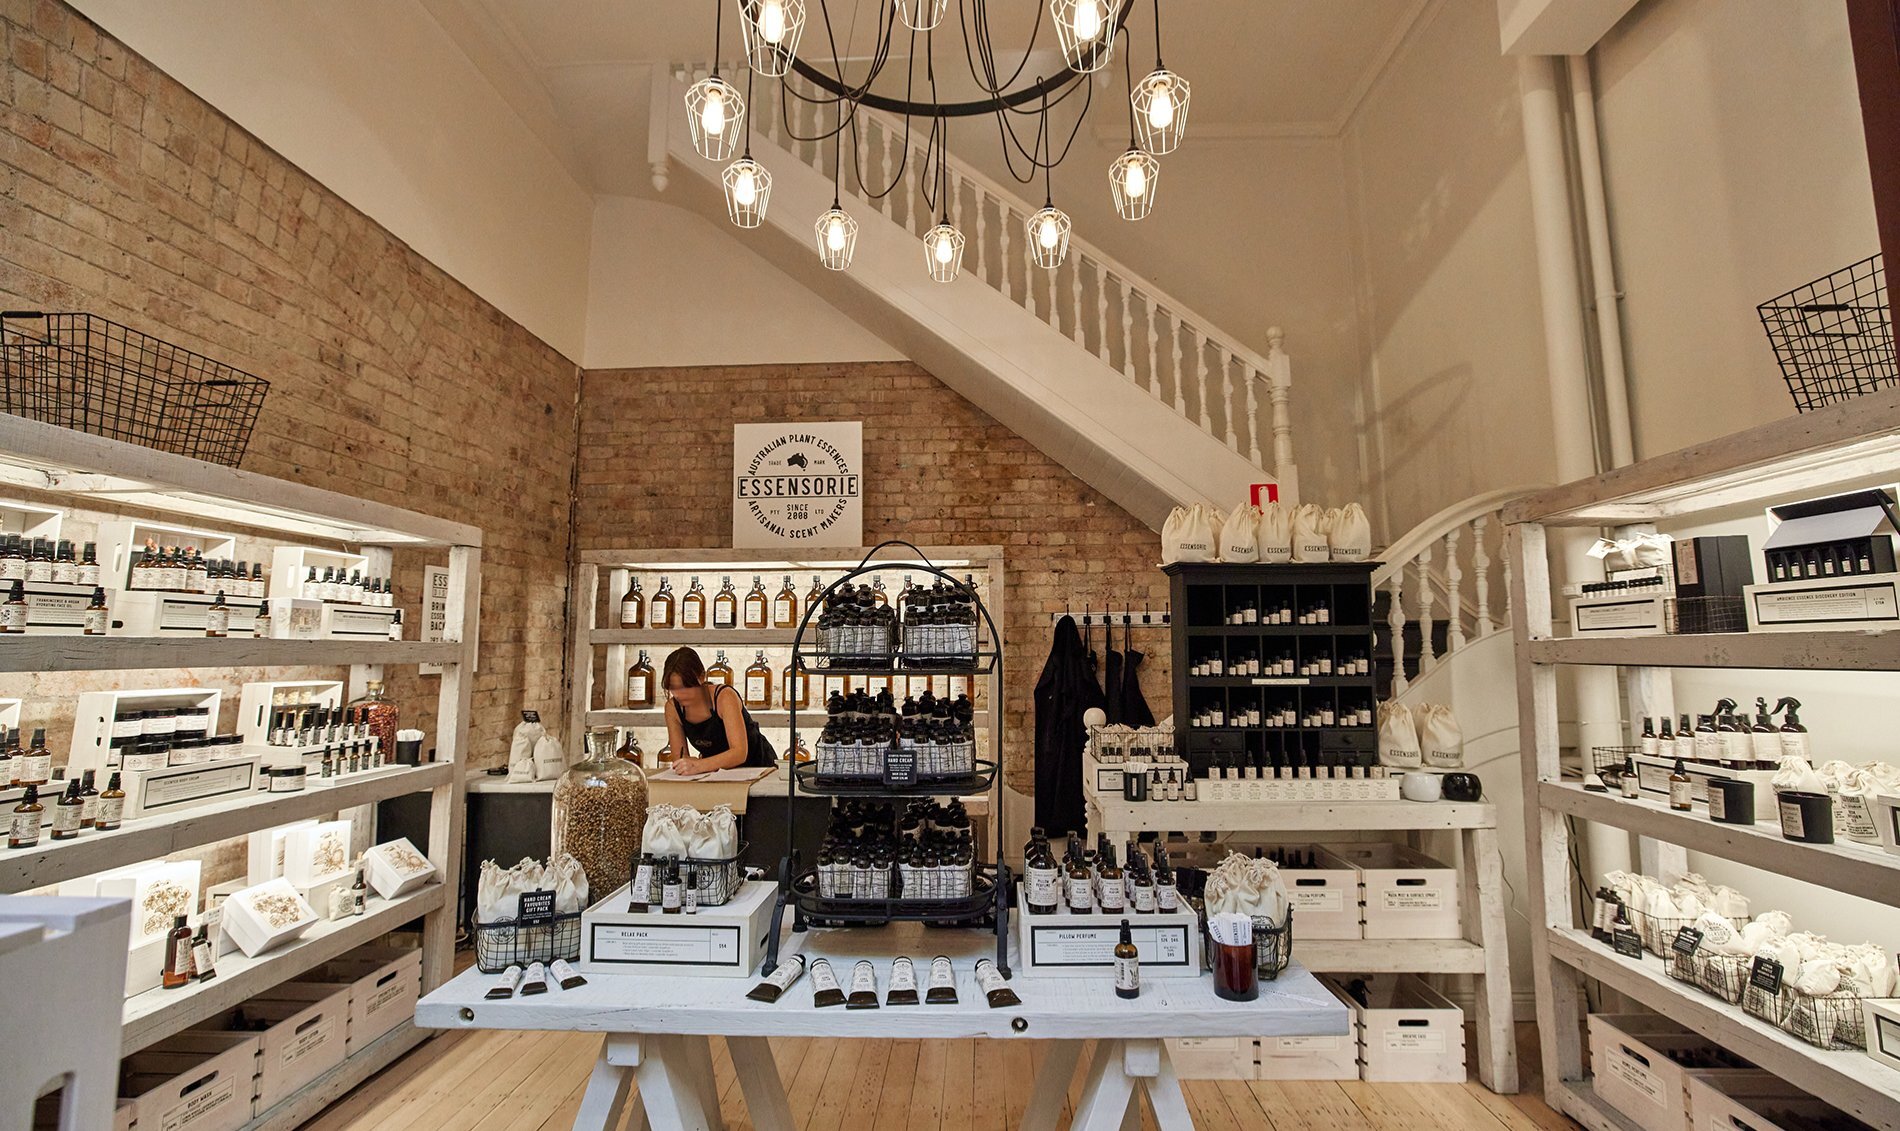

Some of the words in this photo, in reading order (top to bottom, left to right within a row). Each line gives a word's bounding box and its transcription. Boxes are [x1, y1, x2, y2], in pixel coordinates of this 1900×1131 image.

[748, 436, 786, 476] AUSTRALIAN
[789, 434, 816, 445] PLANT
[817, 439, 849, 475] ESSENCES
[739, 477, 857, 497] ESSENSORIE
[787, 504, 809, 512] SINCE
[787, 511, 809, 520] 2008
[748, 500, 786, 537] ARTISANAL
[789, 526, 819, 539] SCENT
[820, 498, 848, 530] MAKERS
